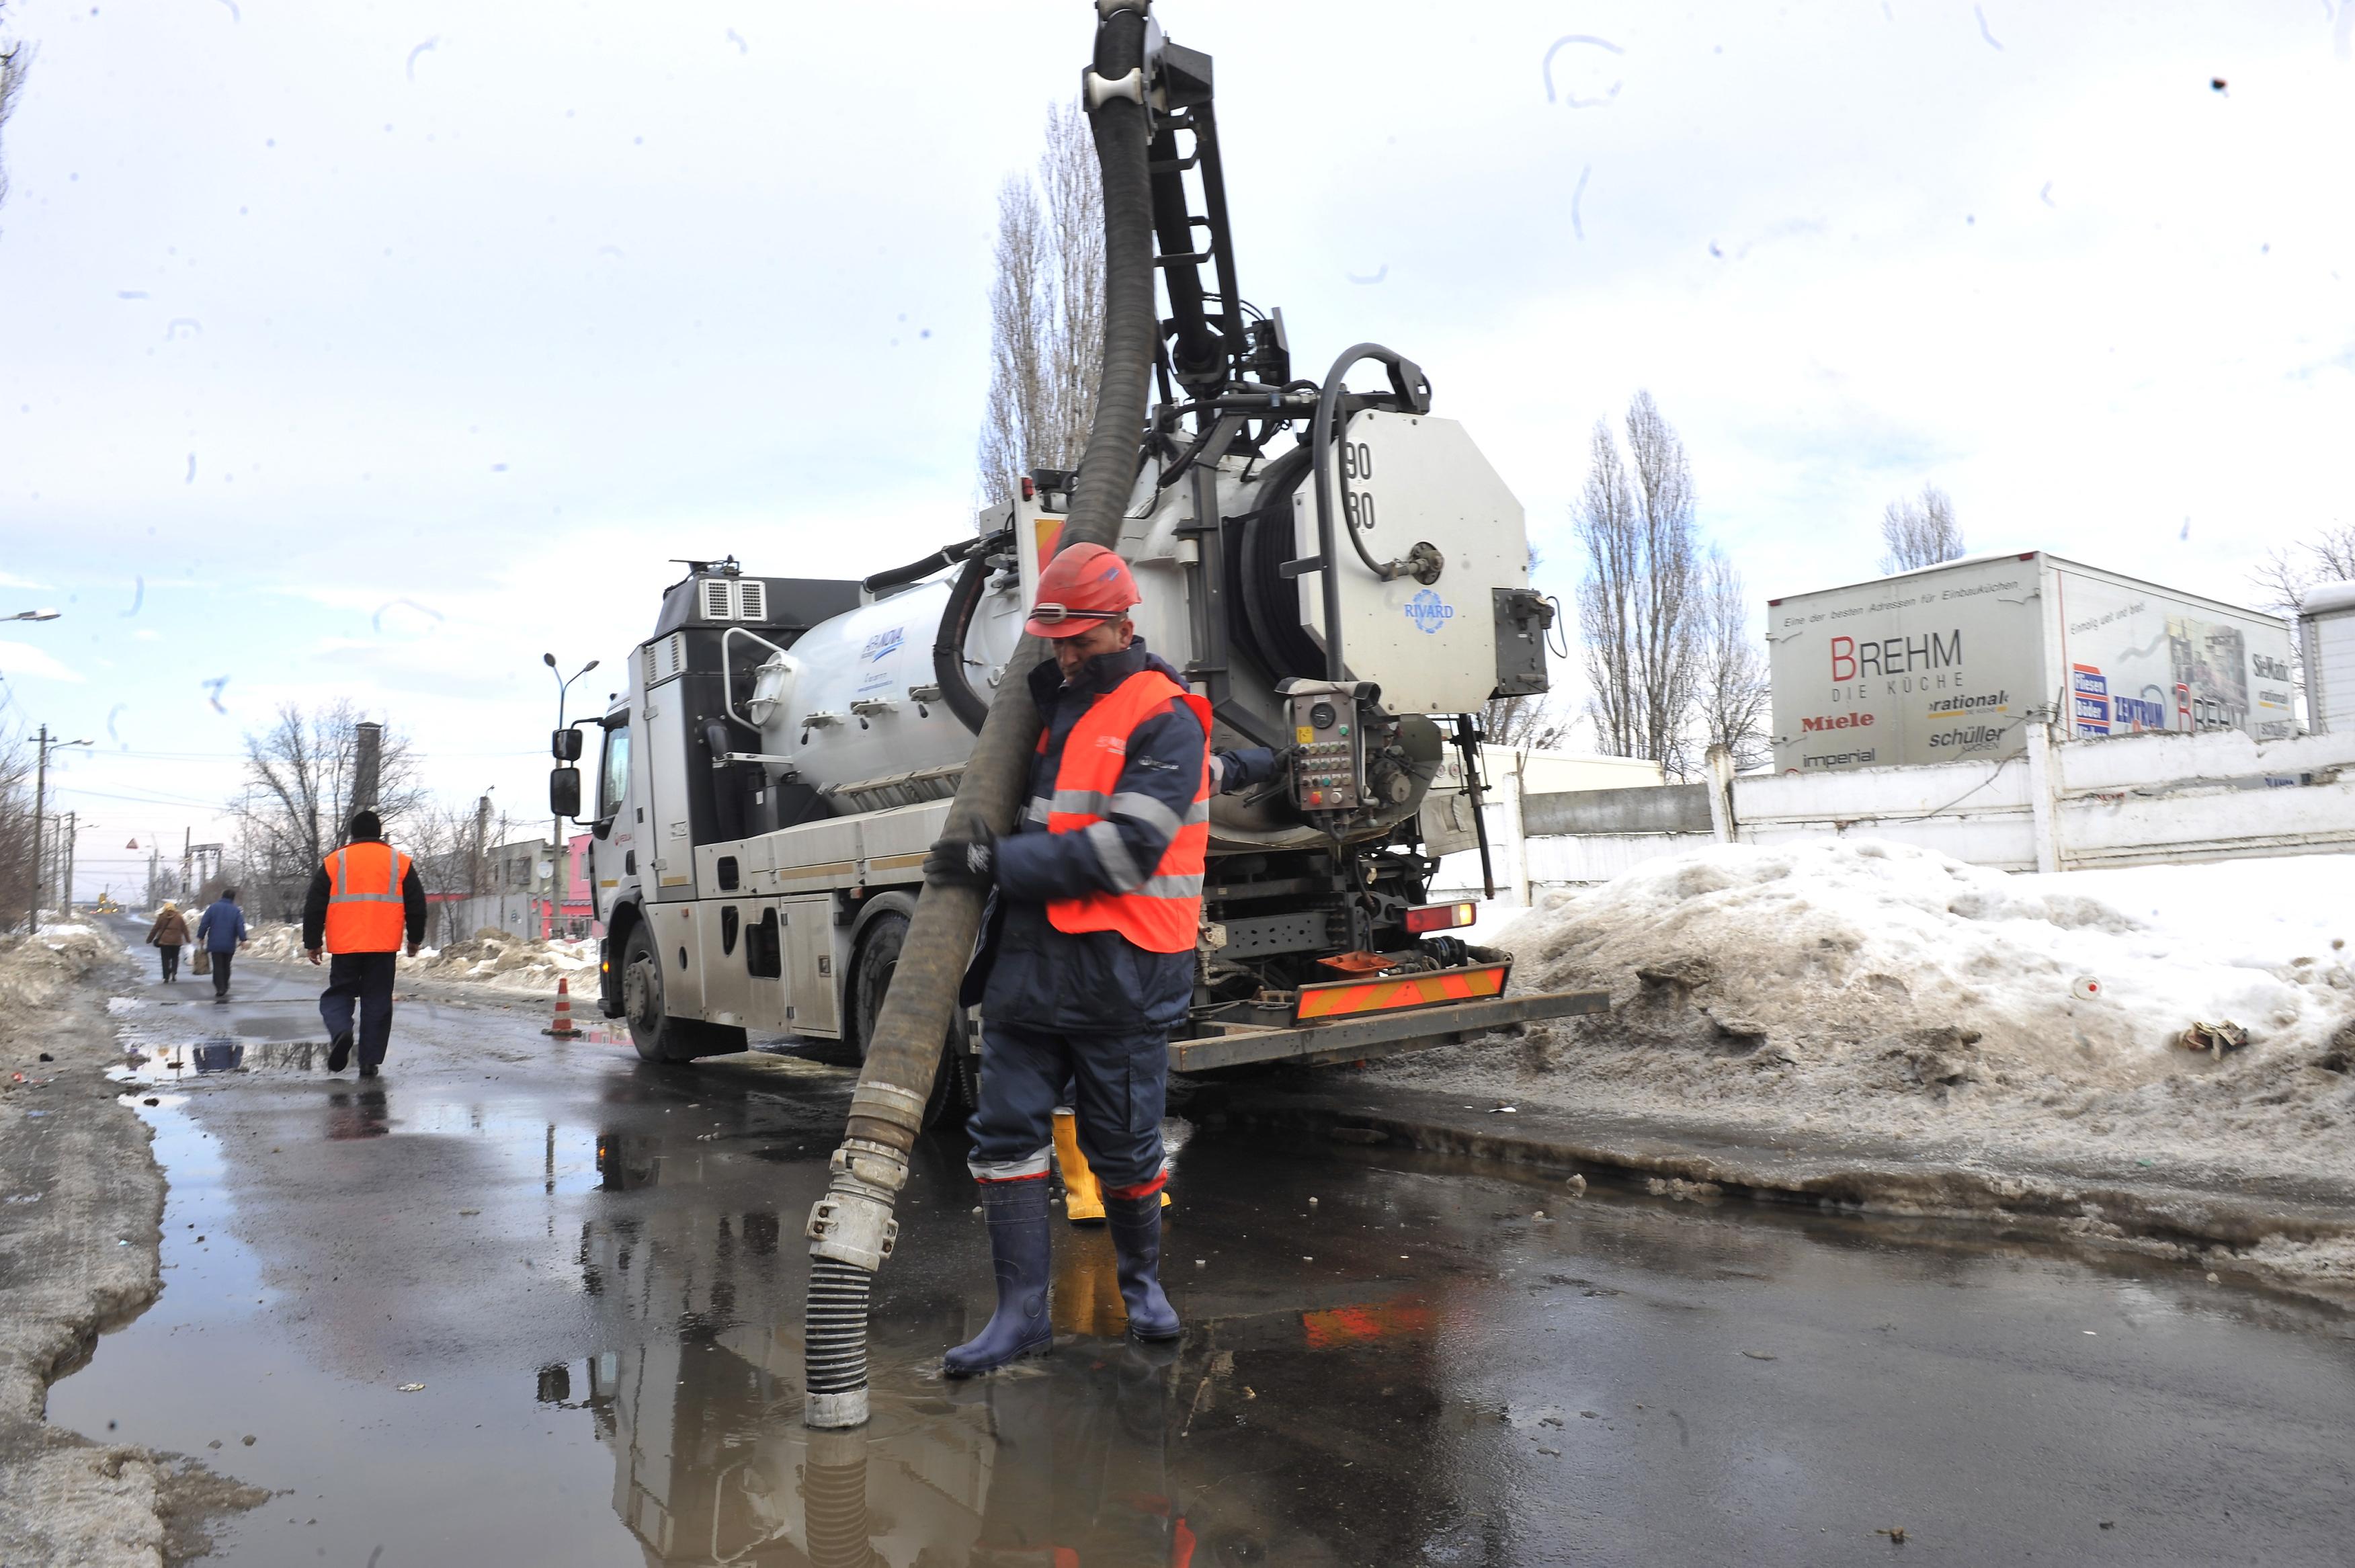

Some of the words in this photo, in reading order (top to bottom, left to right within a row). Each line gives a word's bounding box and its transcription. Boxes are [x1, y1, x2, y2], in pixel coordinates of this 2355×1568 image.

[1346, 442, 1372, 480] 90
[1404, 604, 1454, 619] RIVARD
[1784, 616, 1805, 628] Eine
[1809, 612, 1826, 623] der
[1831, 606, 1864, 619] besten
[1869, 597, 1916, 613] Adressen
[1831, 628, 1963, 682] BREHM
[1832, 684, 1867, 702] DIE
[1887, 671, 1964, 695] KÜCHE
[1801, 712, 1876, 733] Miele
[1928, 725, 2007, 748] schüller
[1802, 747, 1876, 768] imperial
